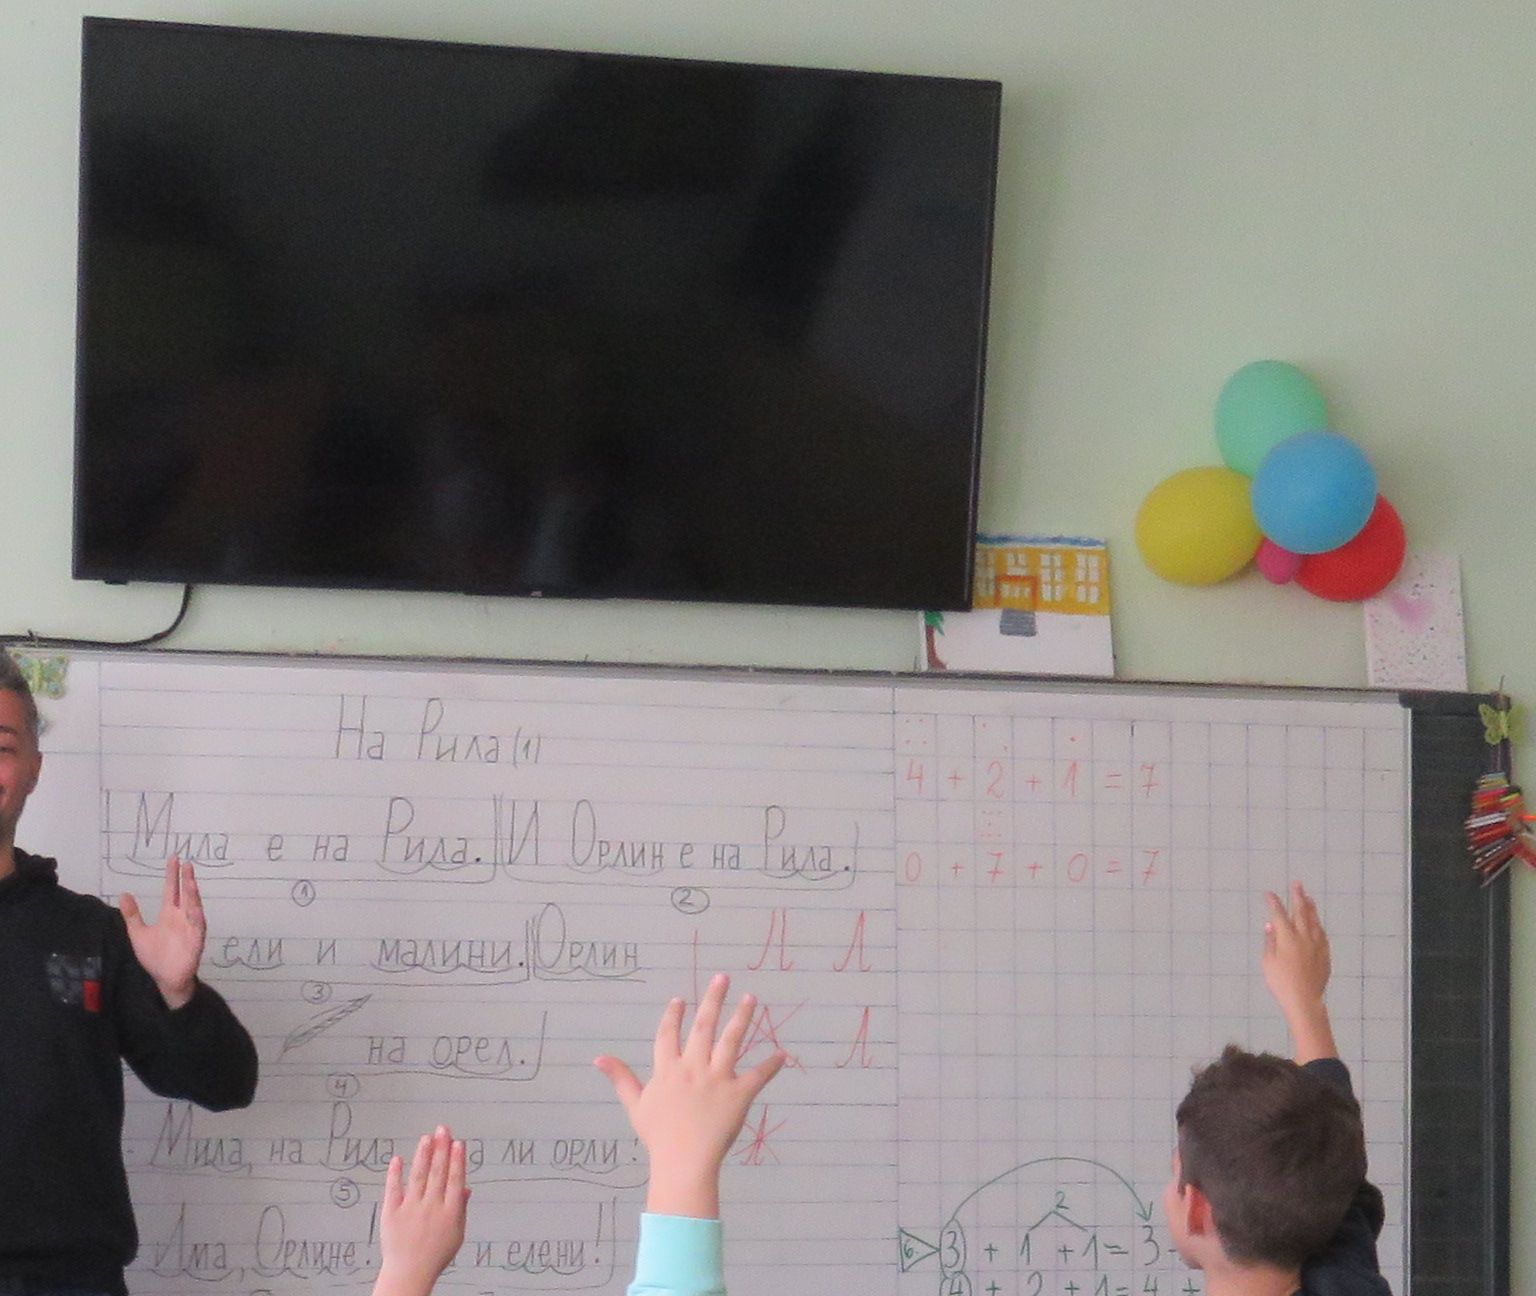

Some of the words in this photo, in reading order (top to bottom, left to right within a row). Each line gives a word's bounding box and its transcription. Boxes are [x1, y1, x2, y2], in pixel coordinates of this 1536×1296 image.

[336, 694, 385, 761] На
[418, 697, 499, 764] Рила
[313, 833, 349, 862] на
[713, 843, 741, 870] на
[368, 1035, 405, 1066] на
[267, 1138, 304, 1164] на
